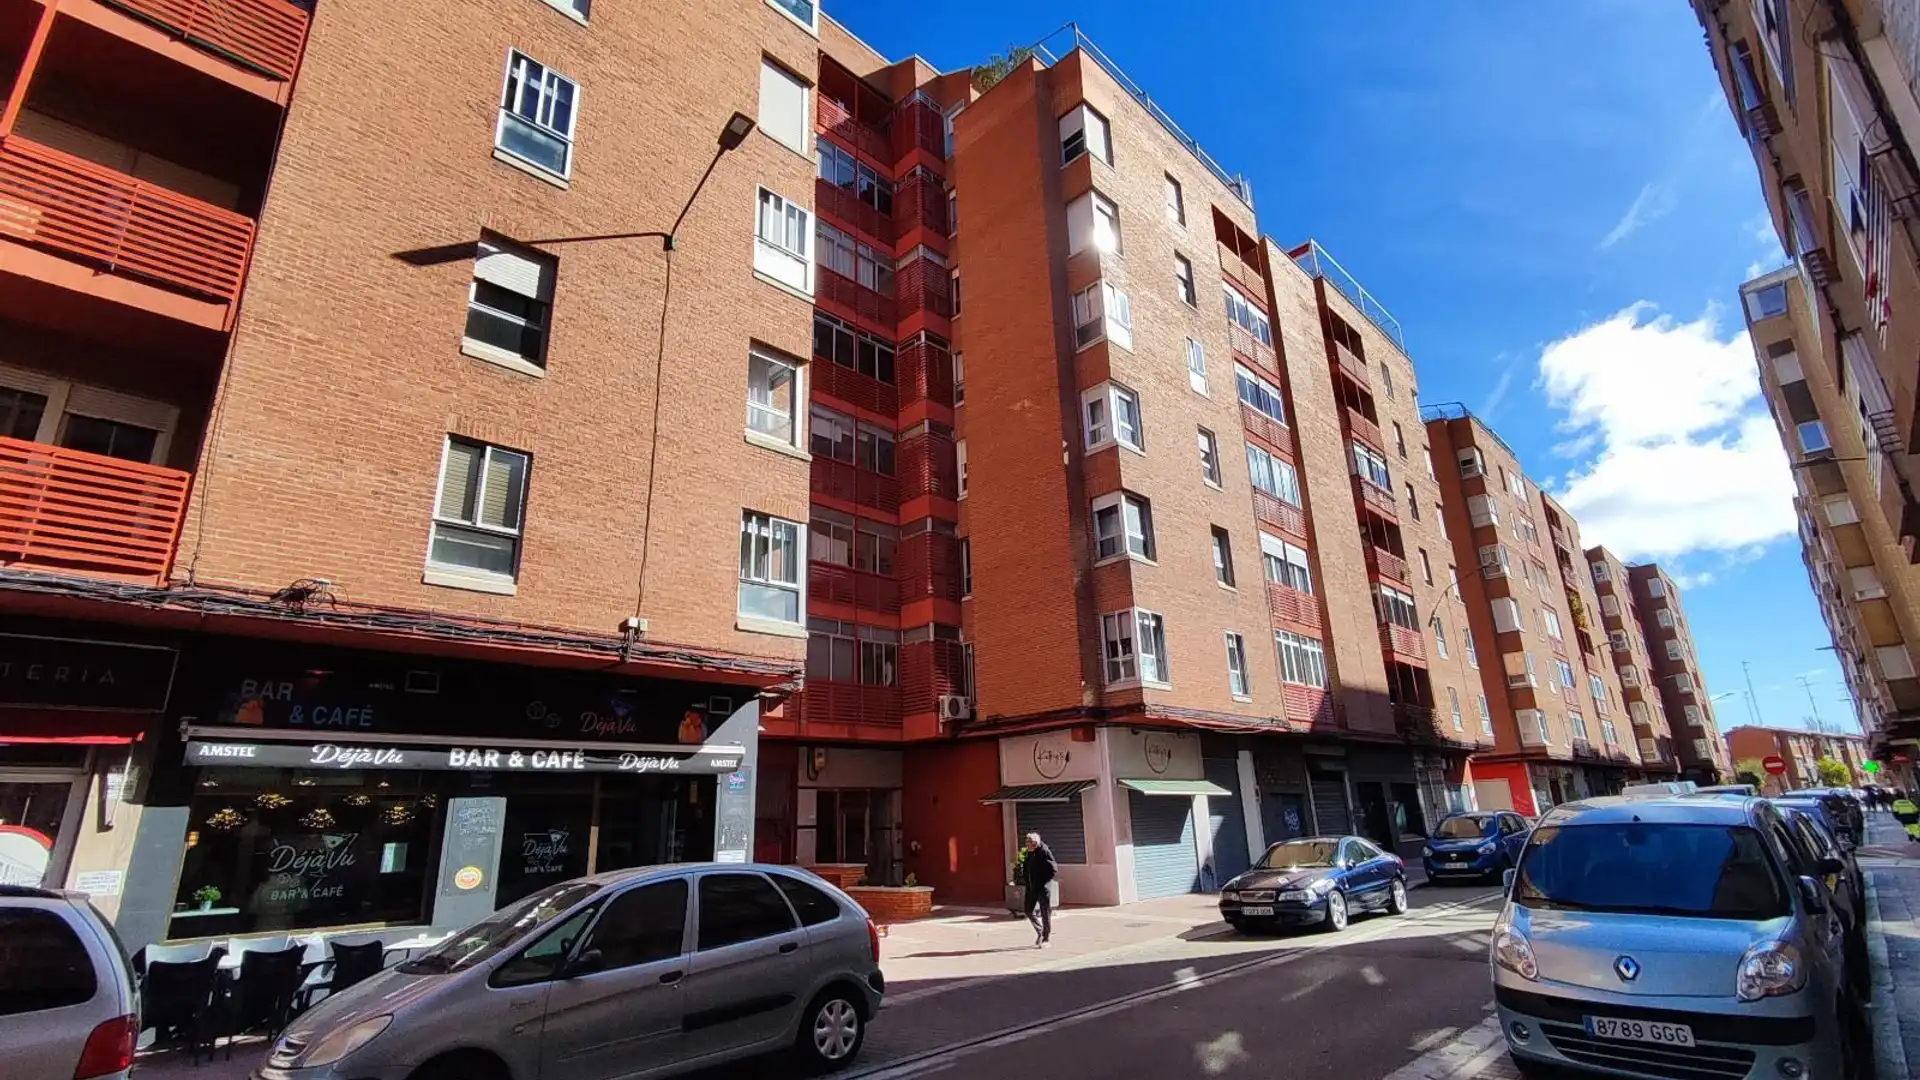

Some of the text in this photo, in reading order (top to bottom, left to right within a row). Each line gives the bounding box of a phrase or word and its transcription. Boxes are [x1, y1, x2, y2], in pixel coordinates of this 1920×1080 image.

[241, 679, 294, 700] BAR
[289, 704, 374, 726] & CAFÉ
[199, 745, 257, 758] AMSTEL
[310, 744, 404, 768] Déjà Vu
[449, 748, 585, 769] BAR & CAFÉ
[618, 753, 680, 773] Déjà Vu
[268, 842, 356, 876] Déjà Vu
[270, 889, 297, 900] BAR
[312, 884, 344, 898] CAFÉ
[1596, 1019, 1689, 1043] 8789 GGG
